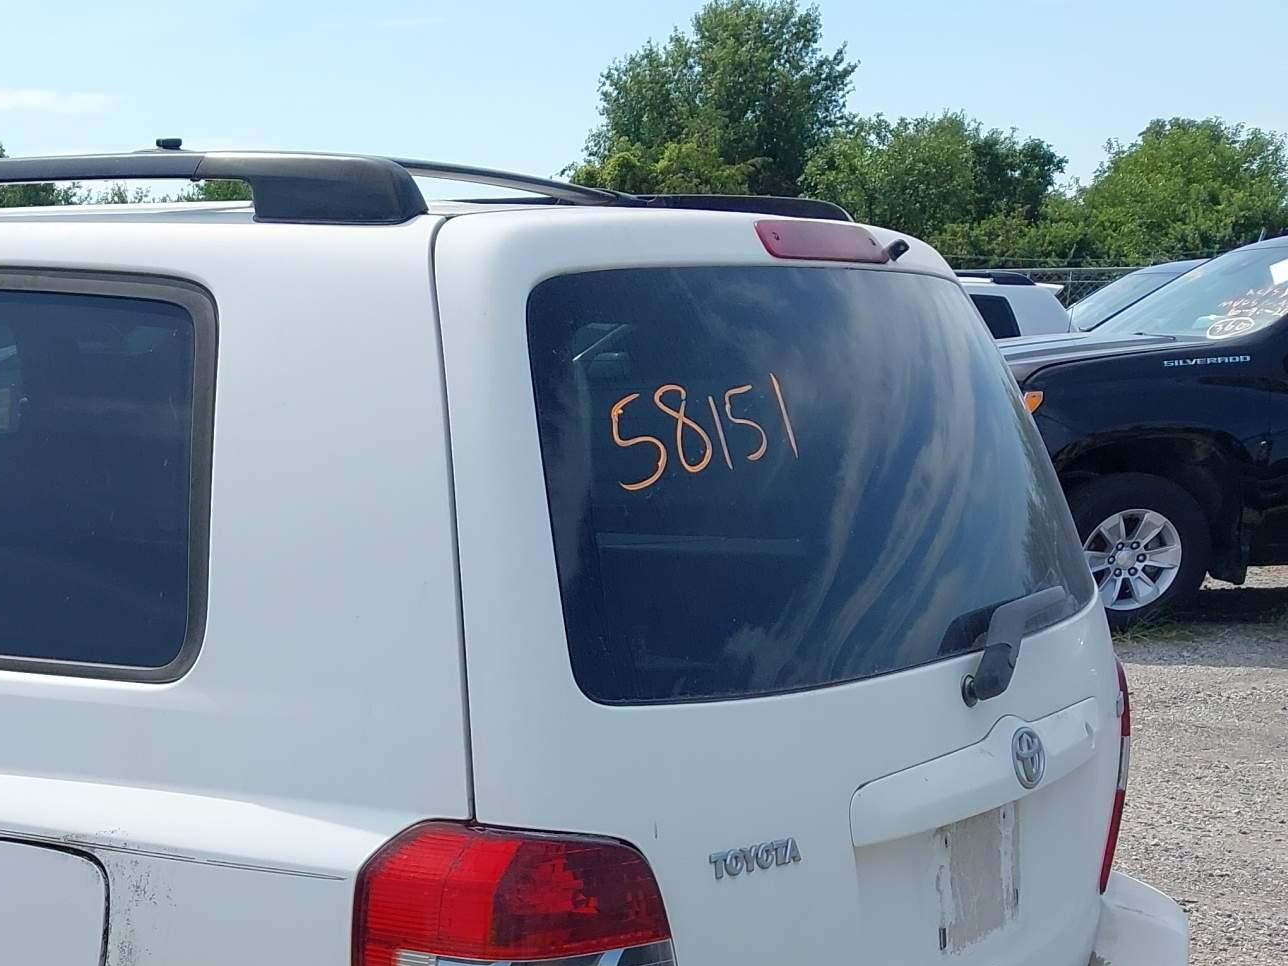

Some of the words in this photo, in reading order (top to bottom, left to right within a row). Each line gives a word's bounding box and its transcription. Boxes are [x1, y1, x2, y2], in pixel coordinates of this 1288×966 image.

[1163, 355, 1251, 367] SILVERADO
[611, 372, 799, 491] 58151
[709, 837, 802, 880] TOYOTA
